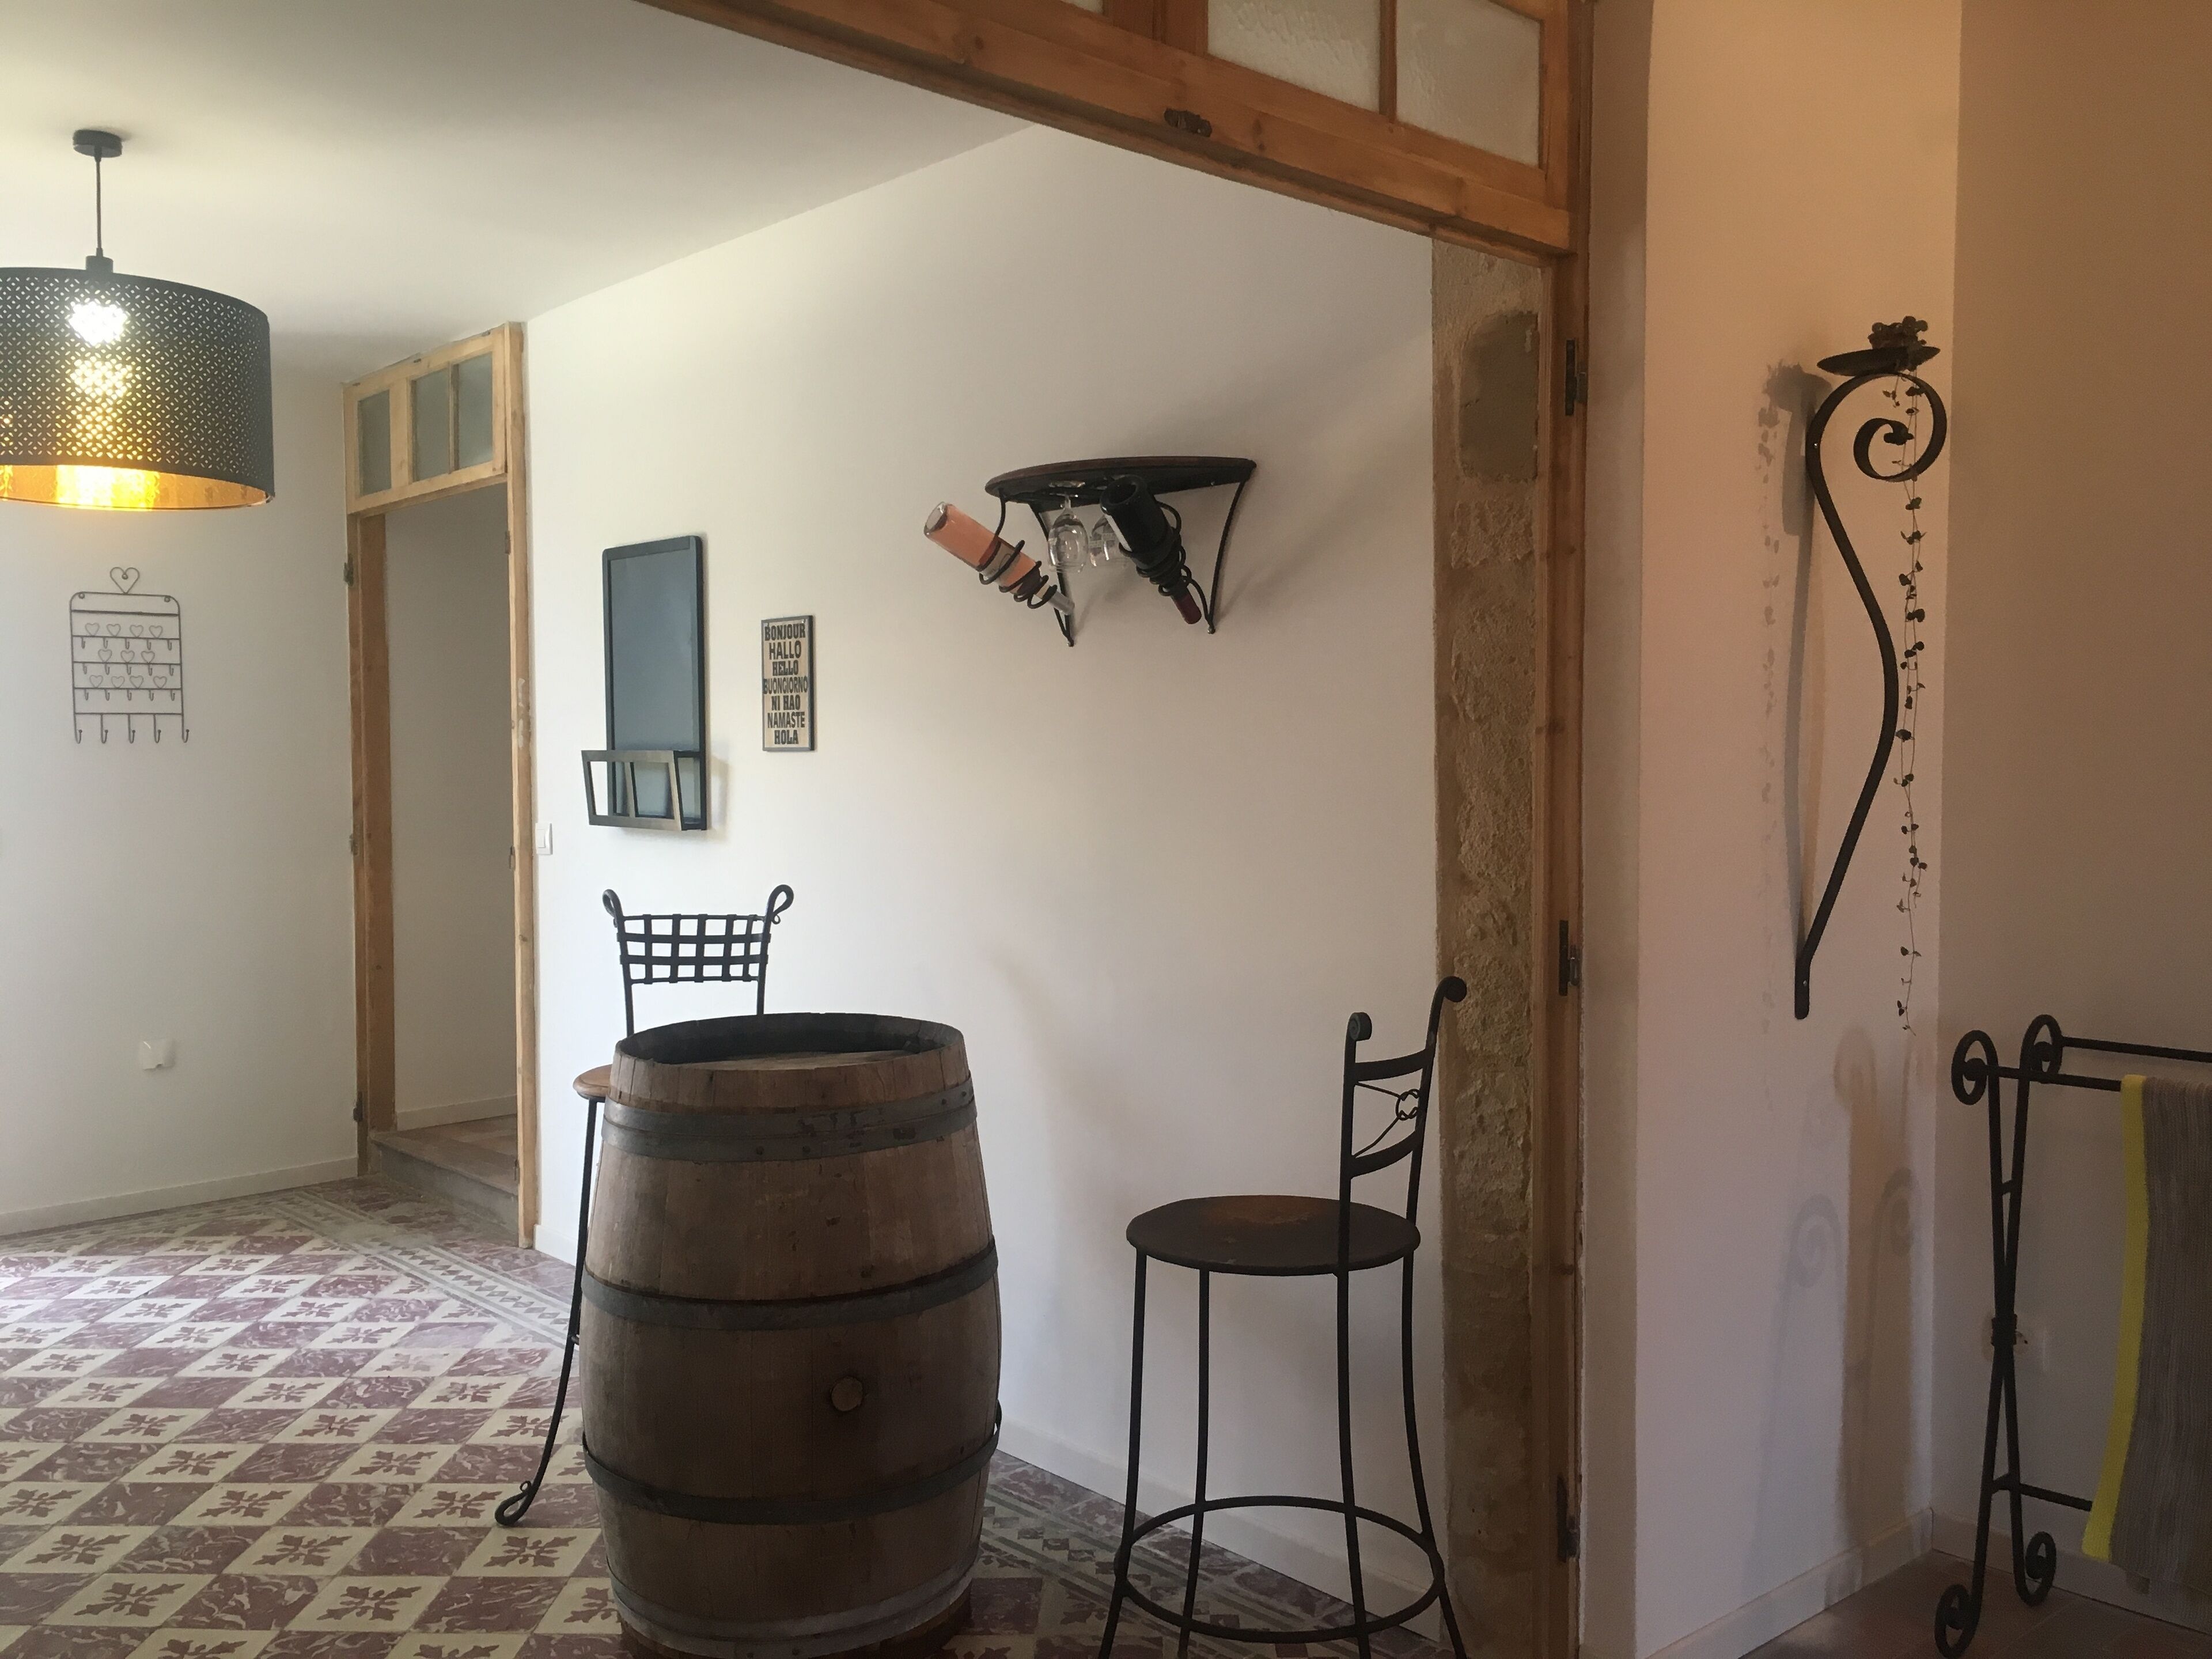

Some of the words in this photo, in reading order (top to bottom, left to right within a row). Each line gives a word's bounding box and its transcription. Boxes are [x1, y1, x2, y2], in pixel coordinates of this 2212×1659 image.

[764, 624, 806, 641] BONJOUR
[769, 640, 802, 660] HALLO
[772, 660, 799, 676] HELLO
[763, 676, 808, 694] BUONGIORNO
[771, 696, 781, 711] NI
[783, 695, 801, 711] HAO
[767, 711, 805, 729] NAMASTE
[774, 729, 799, 745] HOLA
